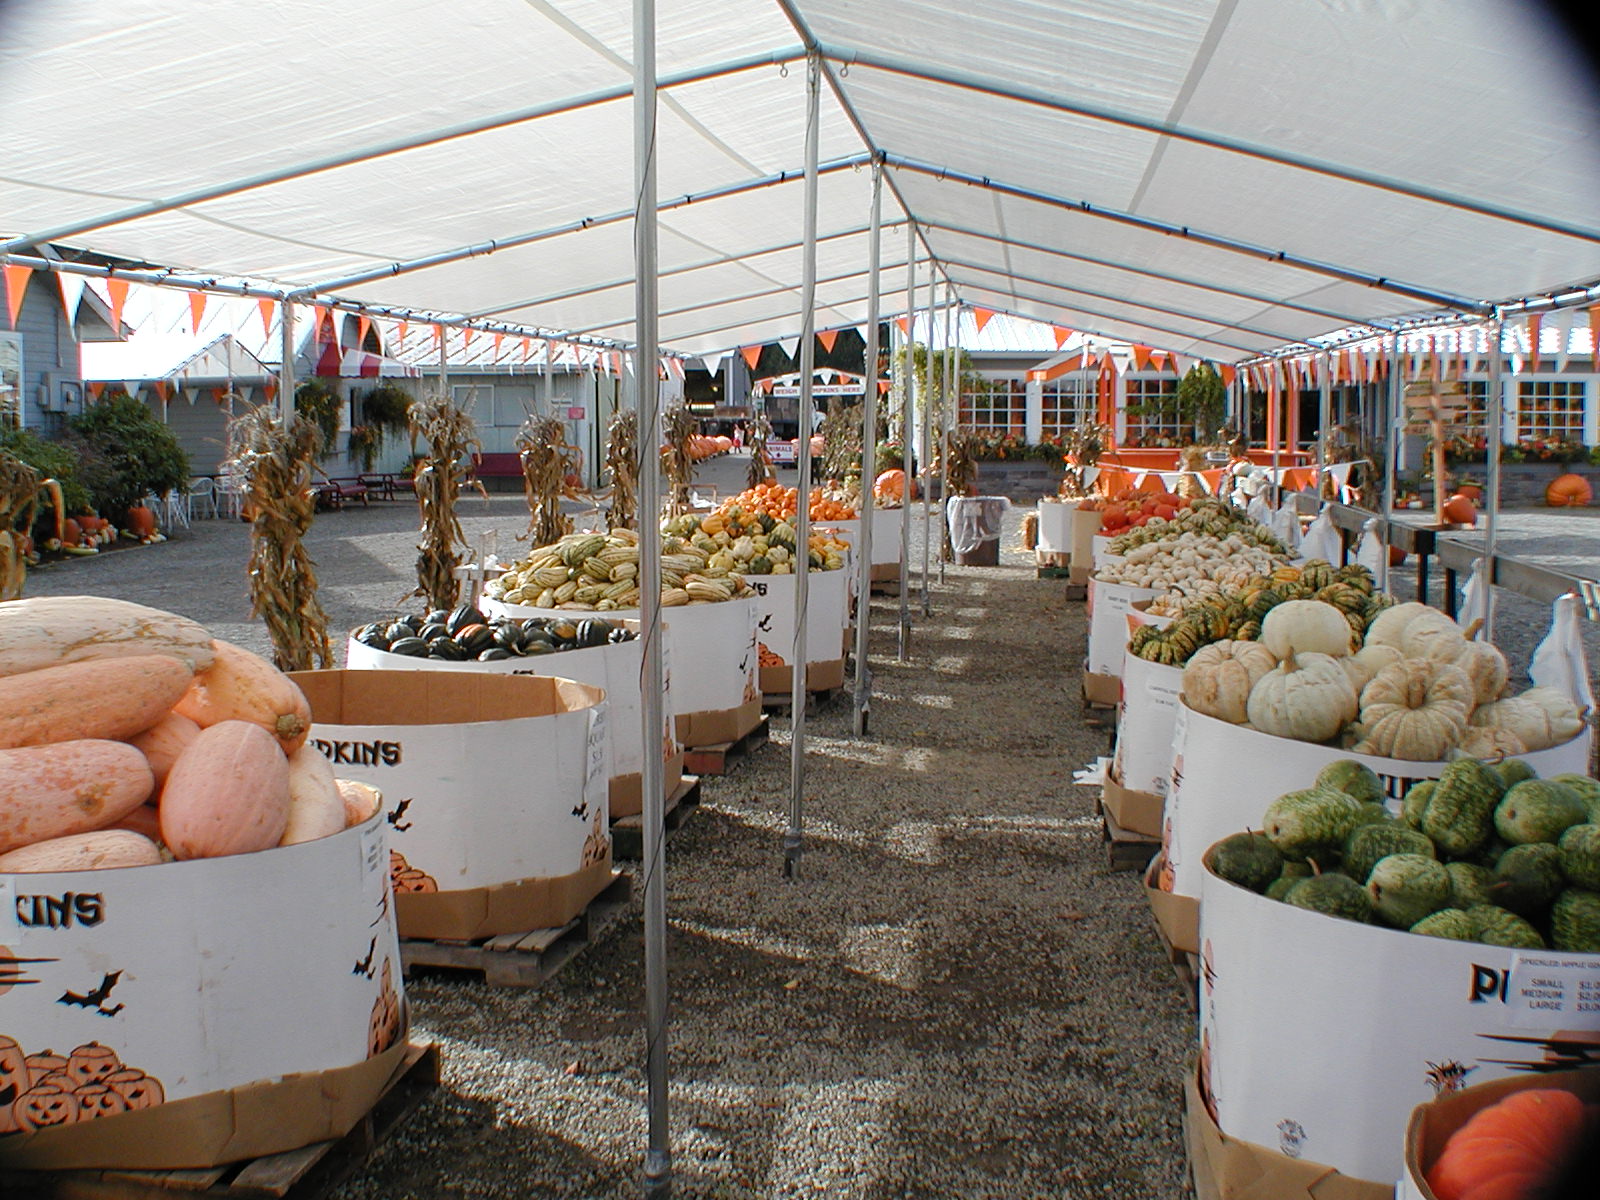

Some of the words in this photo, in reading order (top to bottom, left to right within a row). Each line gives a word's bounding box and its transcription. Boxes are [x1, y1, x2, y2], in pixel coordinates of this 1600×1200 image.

[1531, 978, 1565, 989] SMALL
[1521, 988, 1563, 999] MEDIUM
[1529, 1000, 1562, 1011] LARGE
